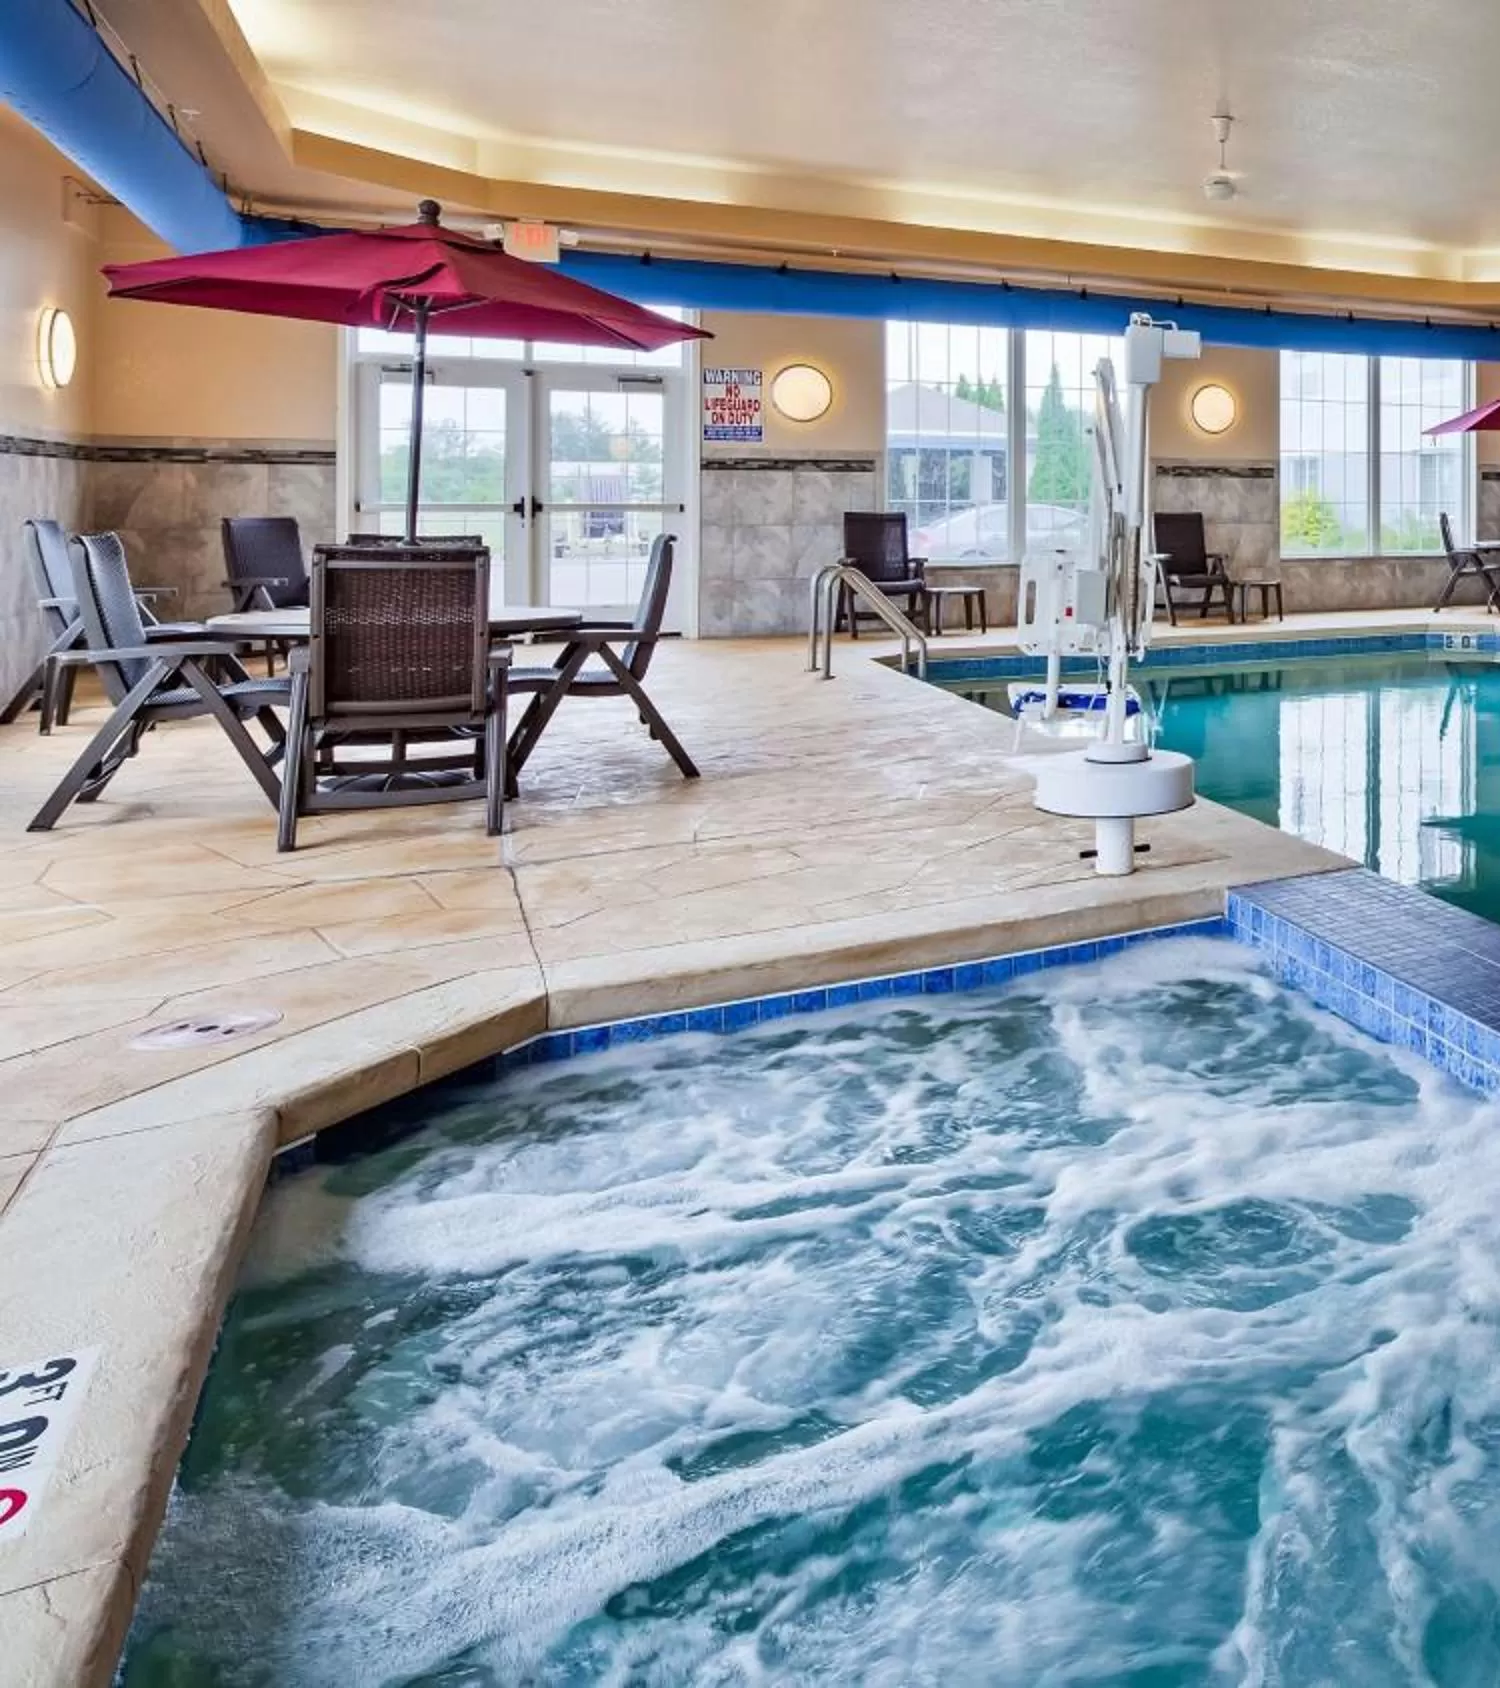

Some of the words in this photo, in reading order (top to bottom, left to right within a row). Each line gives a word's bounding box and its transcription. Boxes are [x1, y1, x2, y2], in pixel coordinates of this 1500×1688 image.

[705, 369, 761, 385] WARNNG
[725, 384, 741, 398] NO
[704, 398, 761, 412] LIFEGUARD
[712, 411, 725, 424] ON
[728, 412, 754, 425] DUTY
